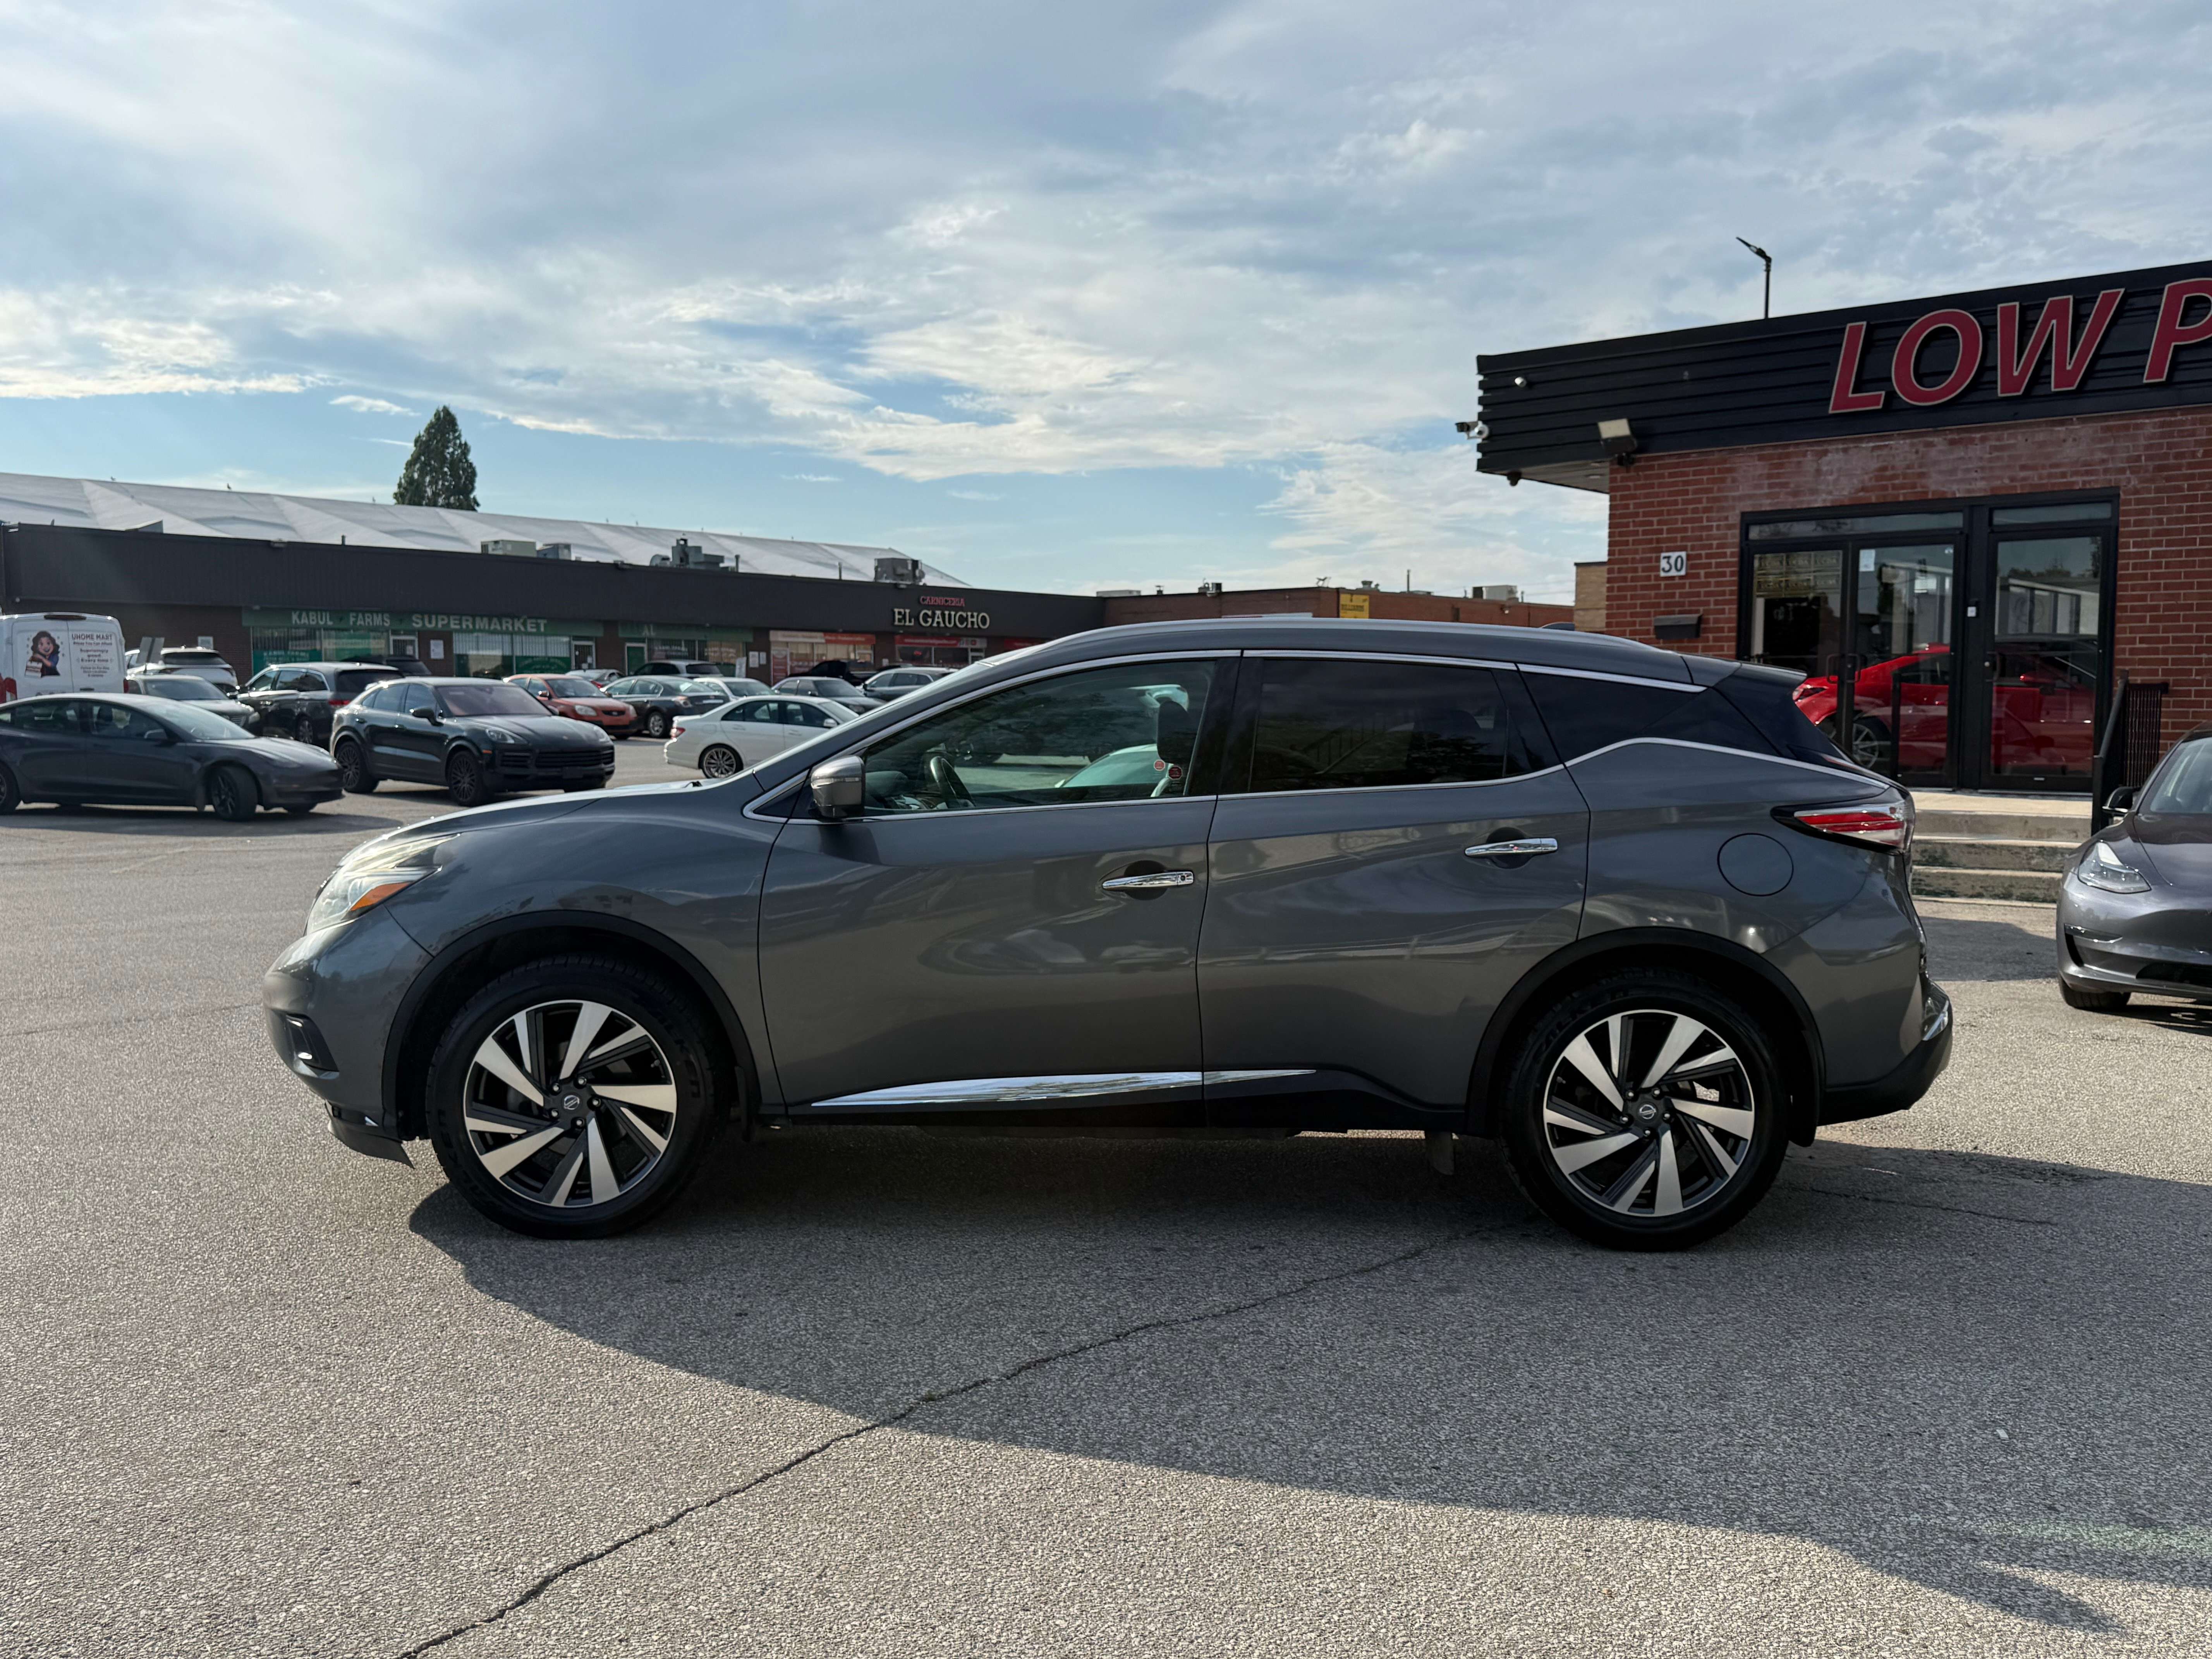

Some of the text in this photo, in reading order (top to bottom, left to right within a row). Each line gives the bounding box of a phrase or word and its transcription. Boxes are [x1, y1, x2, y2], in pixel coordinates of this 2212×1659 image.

[1828, 277, 2212, 414] LOW P
[1661, 555, 1684, 573] 30
[292, 611, 547, 632] KABUL FARMS SUPERMARKET
[894, 608, 990, 629] EL GAUCHO
